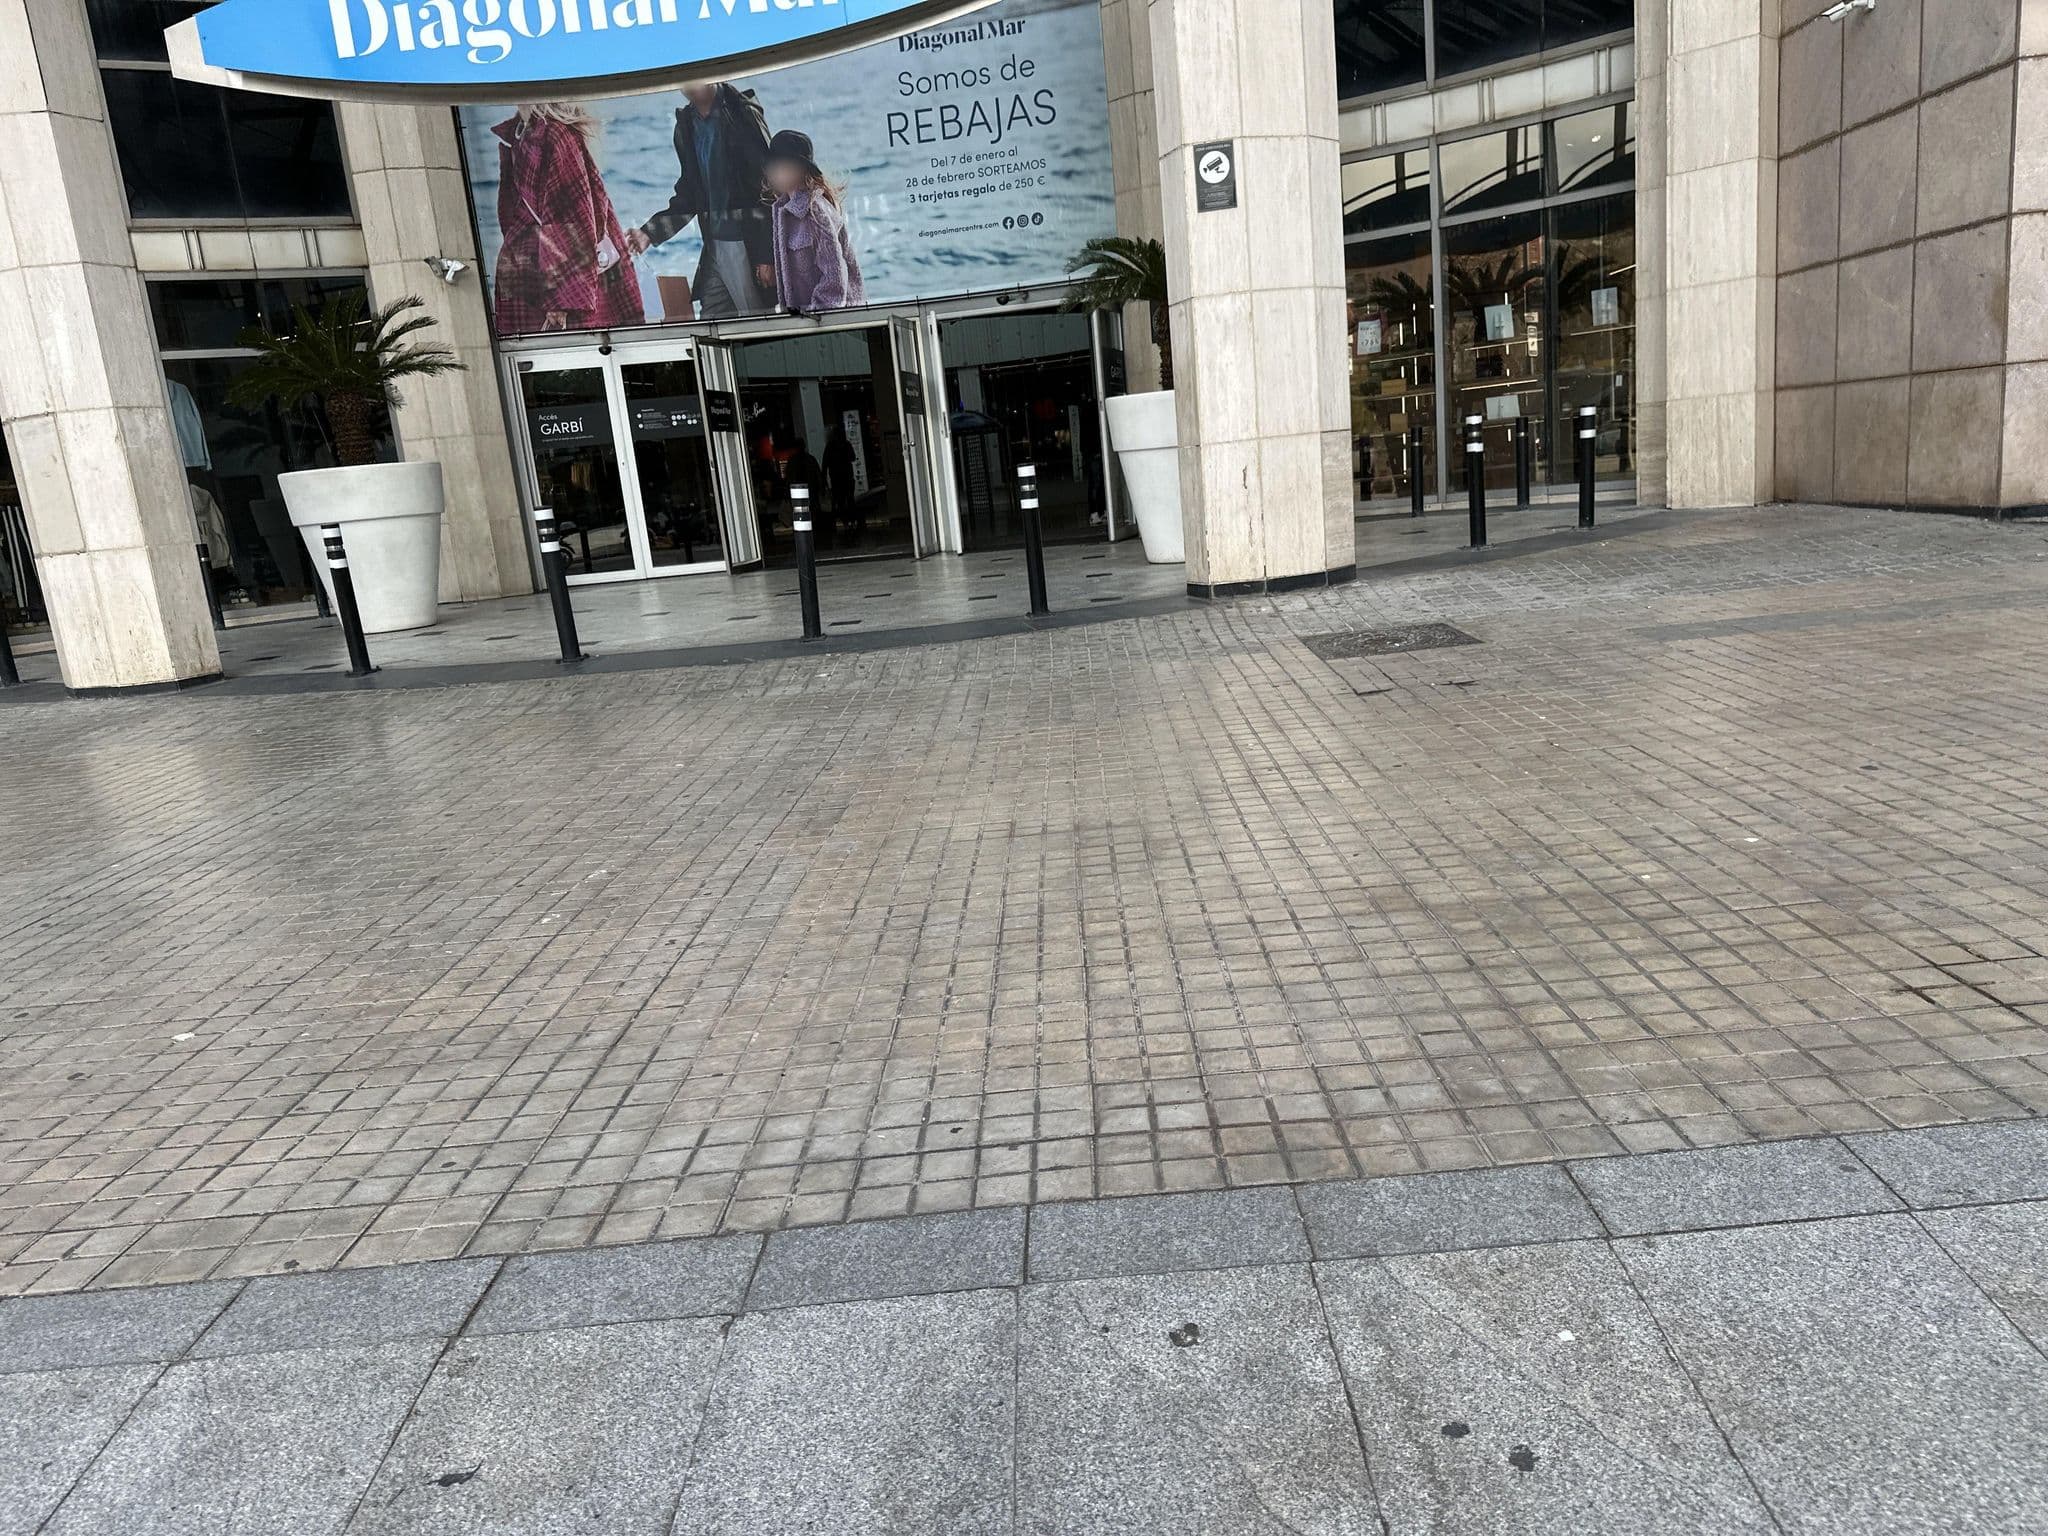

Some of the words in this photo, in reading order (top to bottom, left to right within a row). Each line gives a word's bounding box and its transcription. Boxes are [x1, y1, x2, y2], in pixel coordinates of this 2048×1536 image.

[898, 21, 984, 52] Diagonal
[987, 19, 1026, 39] Mar
[898, 66, 991, 96] Somos
[1000, 53, 1036, 82] de
[886, 88, 1057, 147] REBAJAS
[930, 156, 948, 168] Del
[950, 155, 957, 165] 7
[959, 153, 973, 164] de
[975, 150, 1006, 162] enero
[1008, 146, 1018, 157] al
[905, 177, 919, 188] 28
[921, 175, 935, 186] de
[937, 171, 975, 184] febrero
[977, 158, 1047, 178] SORTEAMOS
[909, 194, 916, 203] 3
[918, 188, 960, 203] tarjetas
[962, 183, 996, 198] regalo
[999, 180, 1012, 191] de
[1014, 177, 1034, 189] 250
[1037, 175, 1046, 186] €
[540, 416, 584, 435] GARBÍ
